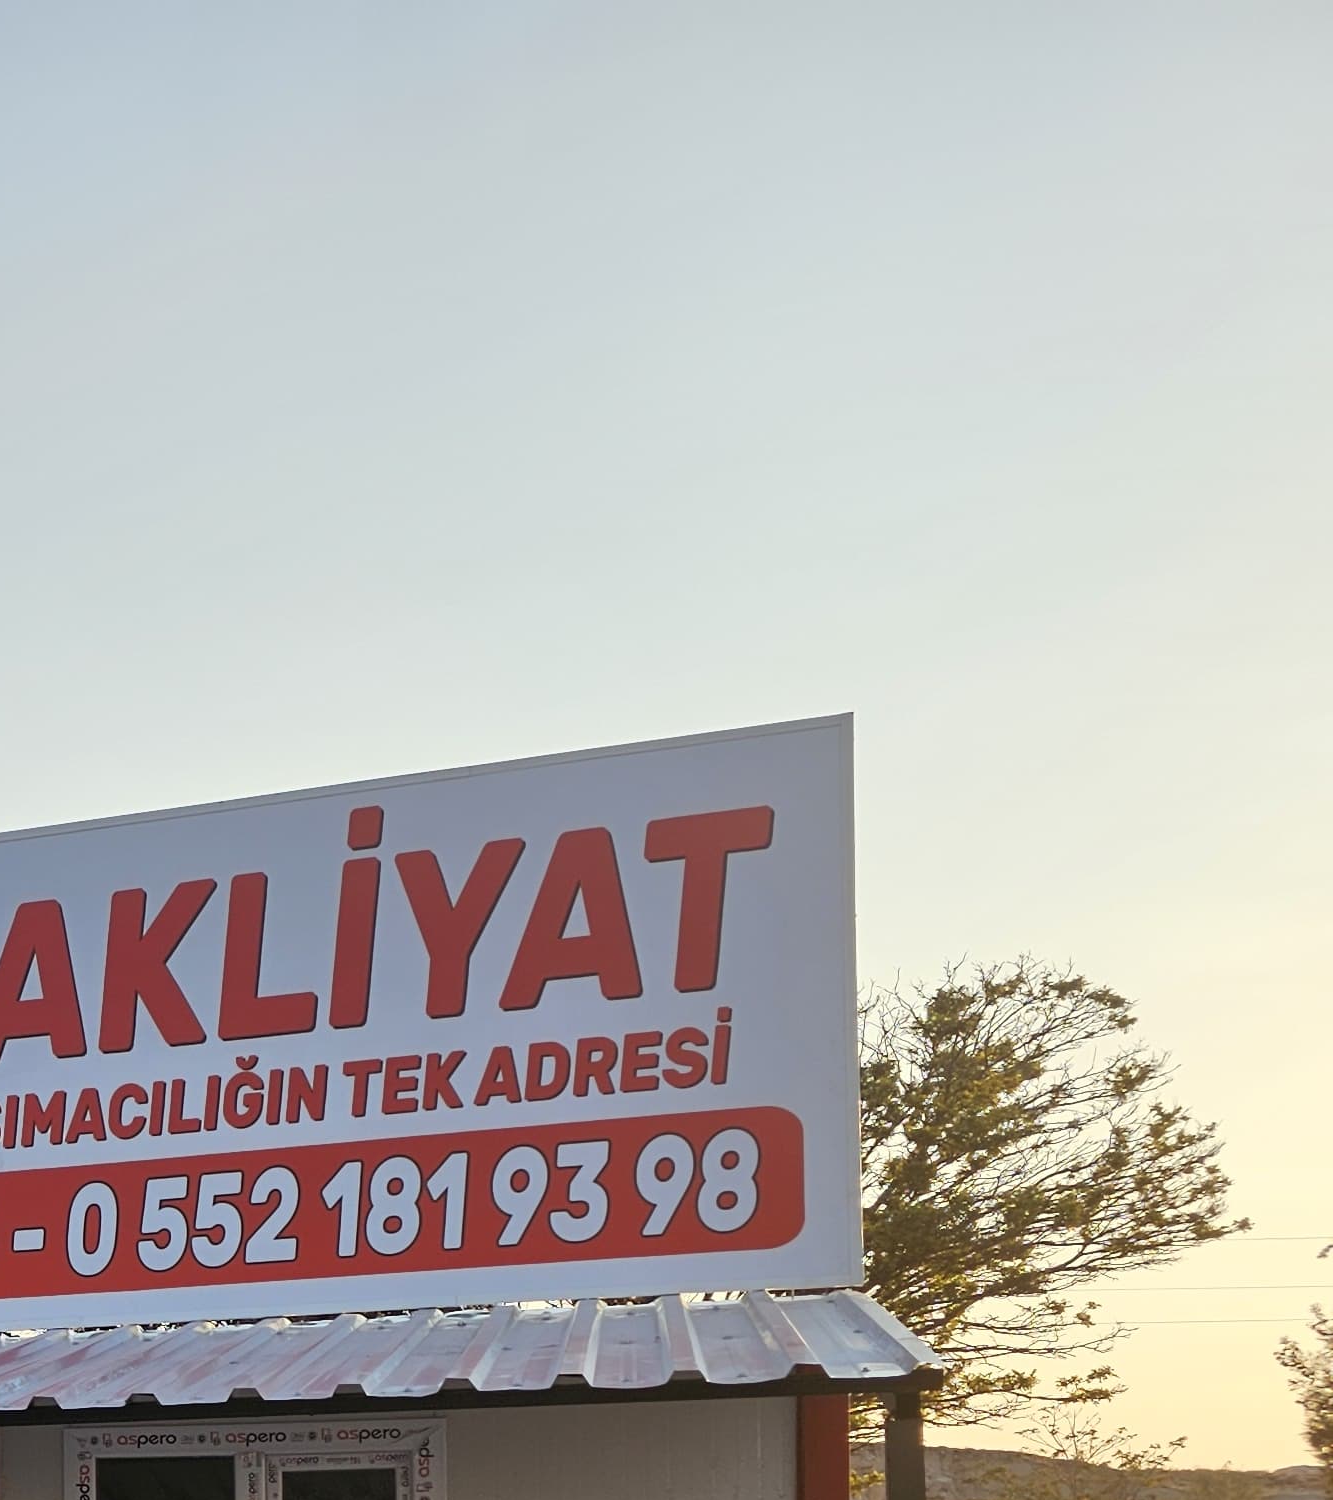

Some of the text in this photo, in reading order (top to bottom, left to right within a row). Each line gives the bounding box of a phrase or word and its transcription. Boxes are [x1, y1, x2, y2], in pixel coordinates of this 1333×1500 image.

[342, 1050, 467, 1118] TEK
[474, 1006, 733, 1106] ADRESİ
[66, 1180, 119, 1278] 0
[136, 1165, 301, 1273] 552
[320, 1151, 472, 1259] 181
[491, 1139, 613, 1248] 93
[634, 1126, 760, 1238] 98
[117, 1428, 401, 1448] aspero aspero aspero
